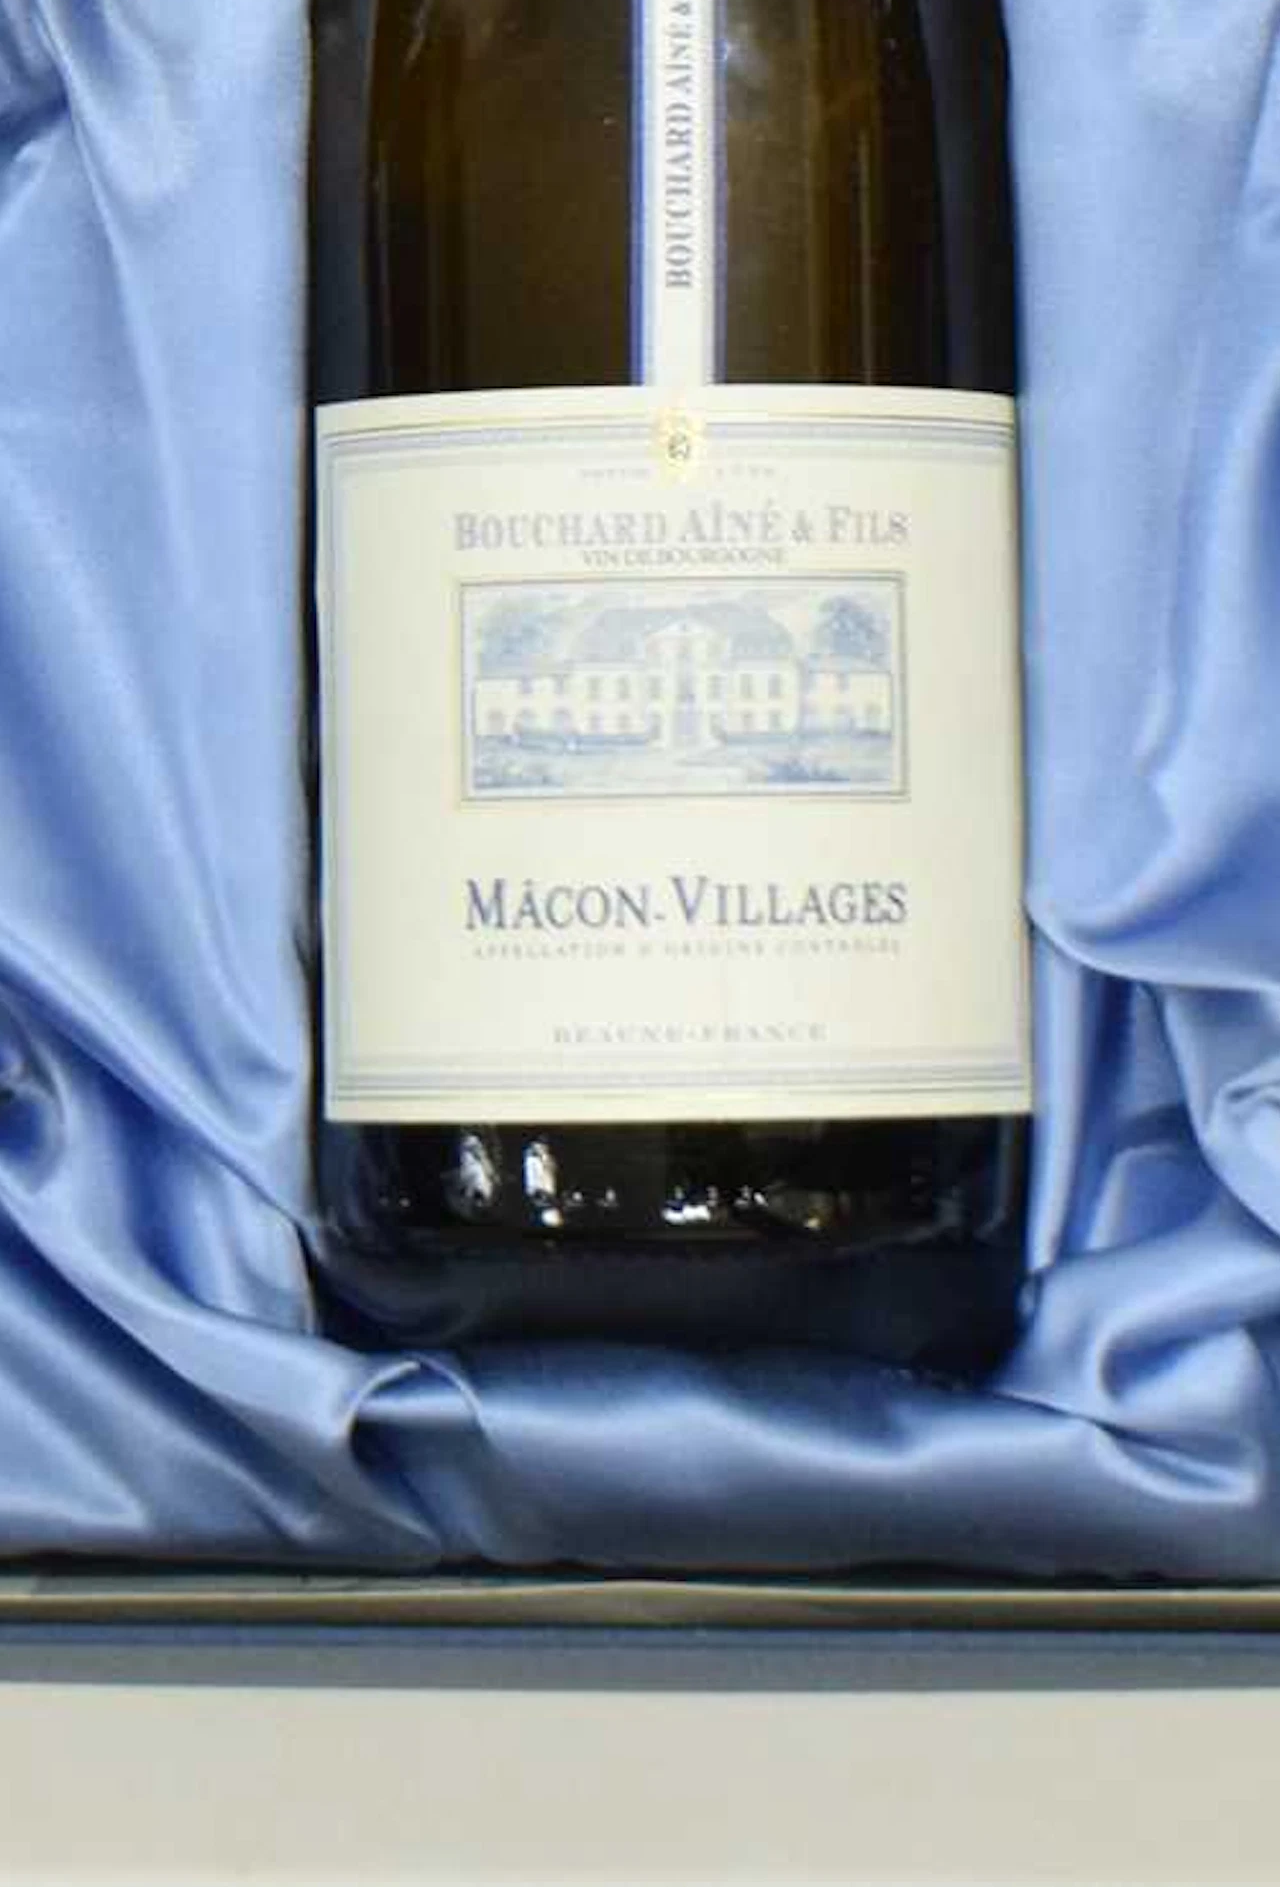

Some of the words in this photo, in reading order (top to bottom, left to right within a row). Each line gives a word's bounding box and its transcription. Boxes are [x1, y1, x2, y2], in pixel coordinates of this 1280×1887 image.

[664, 102, 693, 289] BOUCHARD
[453, 510, 667, 552] BOUCHARD
[789, 509, 813, 544] &
[824, 504, 911, 544] FILS
[582, 549, 619, 566] VIN
